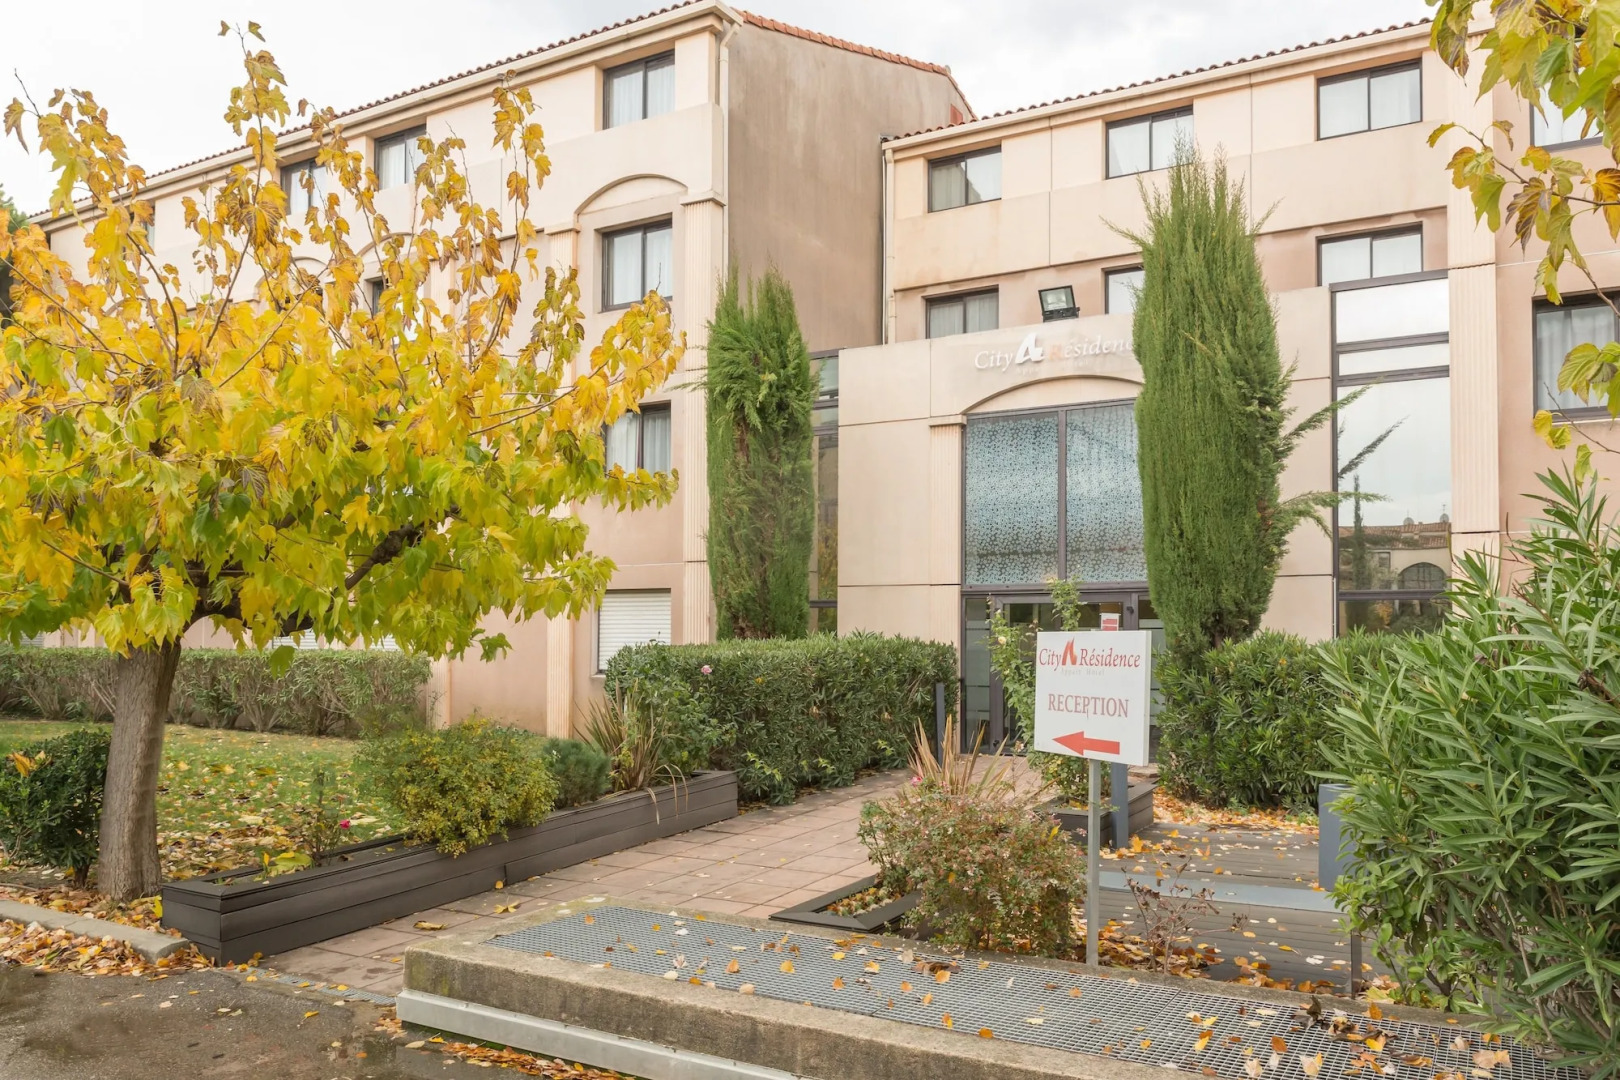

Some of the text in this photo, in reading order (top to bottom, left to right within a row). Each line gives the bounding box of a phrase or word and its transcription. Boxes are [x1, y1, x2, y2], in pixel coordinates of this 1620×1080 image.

[975, 350, 1013, 371] City
[1050, 335, 1133, 361] Résidenc
[1039, 648, 1141, 671] City Résidence
[1048, 693, 1129, 718] RECEPTION
